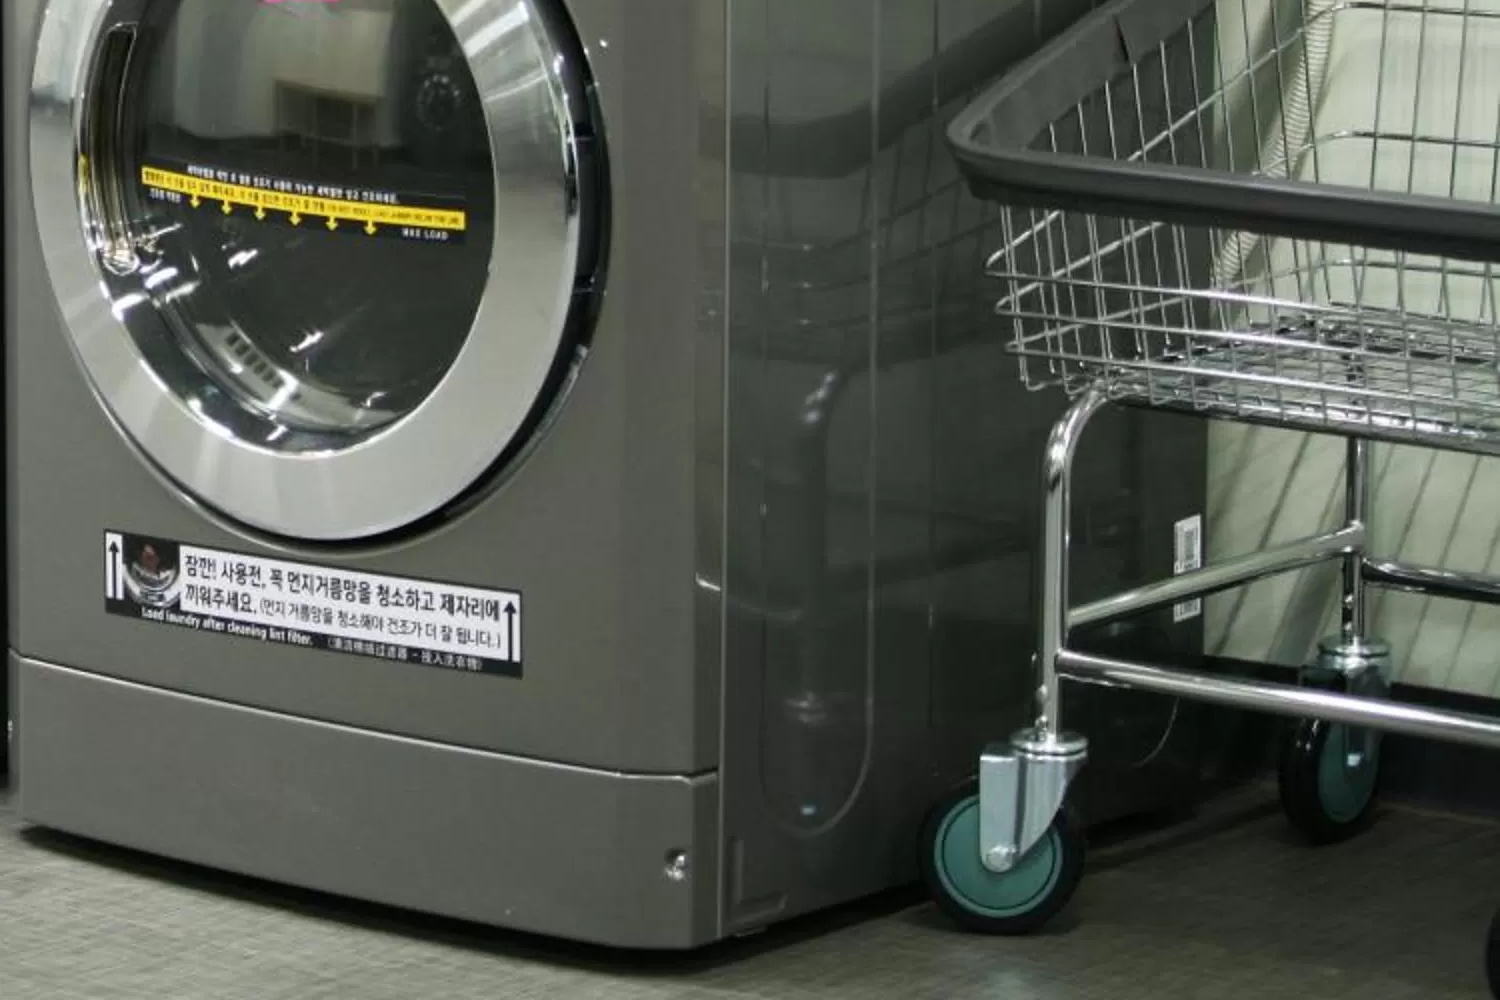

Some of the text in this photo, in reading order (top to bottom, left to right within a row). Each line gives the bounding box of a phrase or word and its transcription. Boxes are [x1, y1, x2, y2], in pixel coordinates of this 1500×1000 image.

[184, 554, 500, 622] 잠깐! 사용전, 꼭 먼지거름망을 청소하고 제자리에
[185, 583, 257, 615] 끼워주세요.
[288, 602, 334, 627] 거름망을
[337, 609, 384, 632] 청소해야
[387, 616, 423, 639] 건조가
[425, 622, 437, 640] 더
[440, 624, 453, 643] 잘
